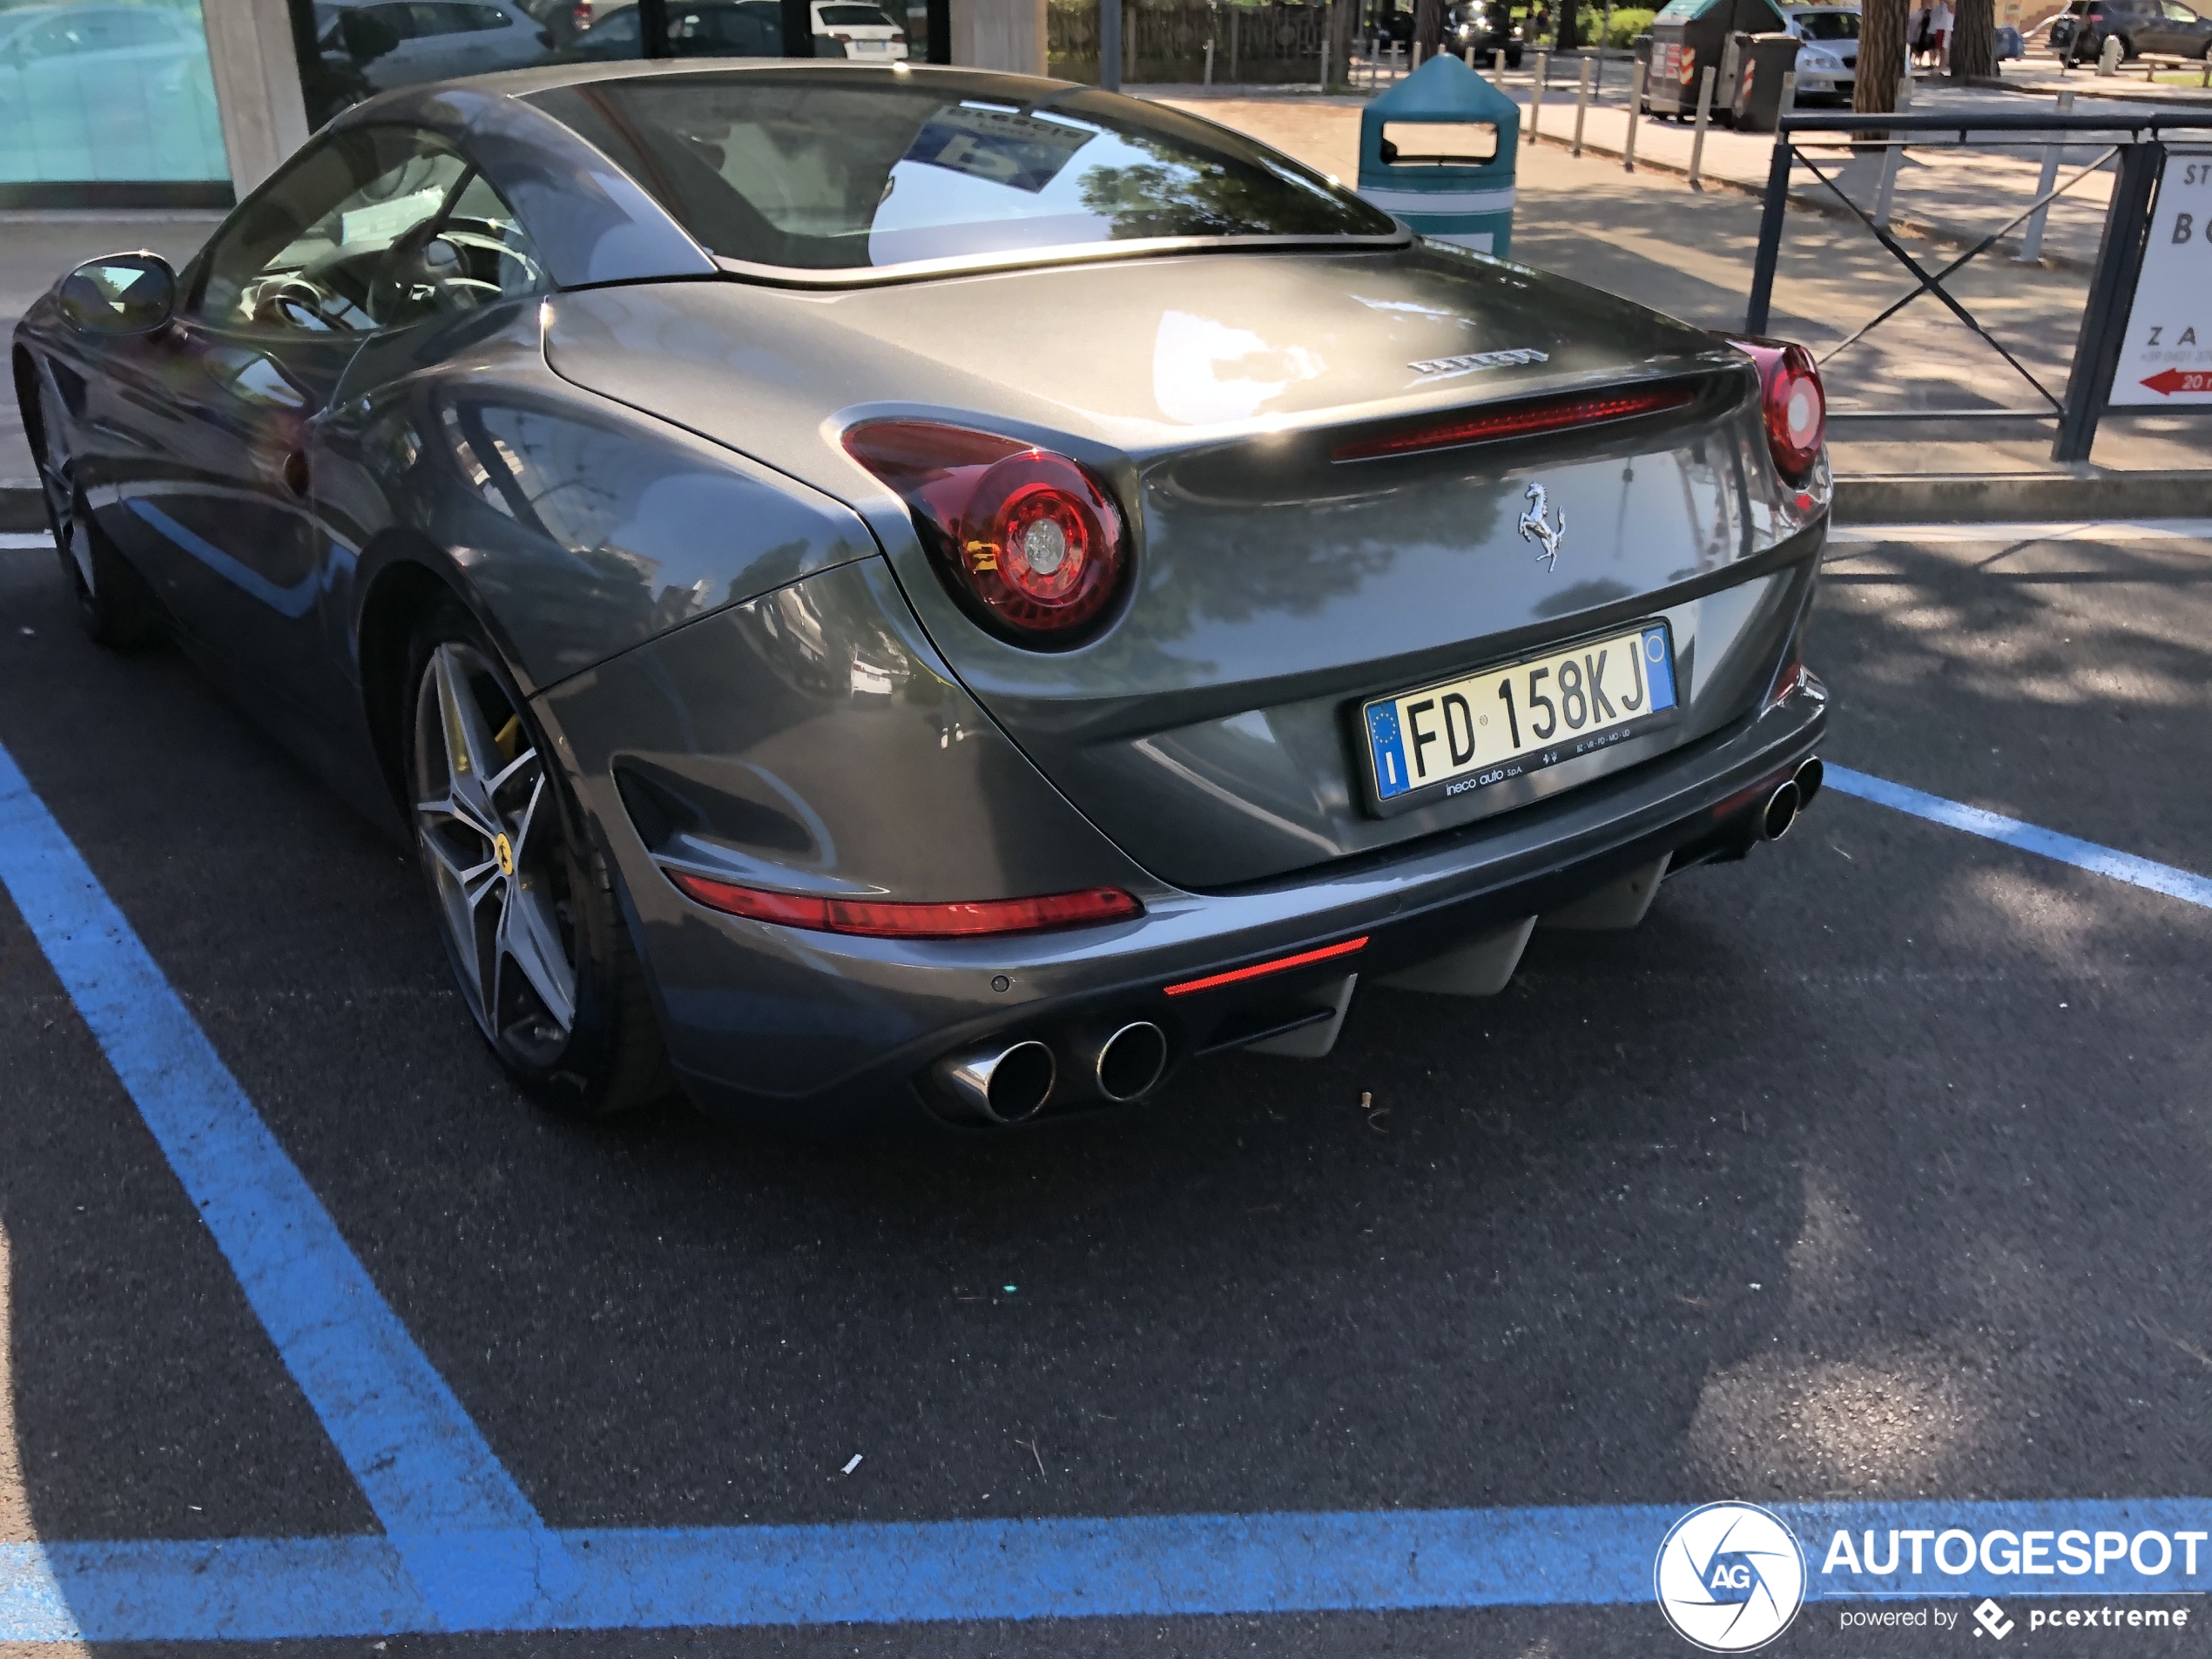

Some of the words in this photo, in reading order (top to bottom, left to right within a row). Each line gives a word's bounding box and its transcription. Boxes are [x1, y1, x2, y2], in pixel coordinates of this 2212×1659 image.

[2182, 374, 2203, 389] 20
[1406, 692, 1475, 778] FD
[1499, 642, 1643, 749] 158KJ
[1446, 779, 1477, 796] ineco
[1480, 769, 1504, 786] auto
